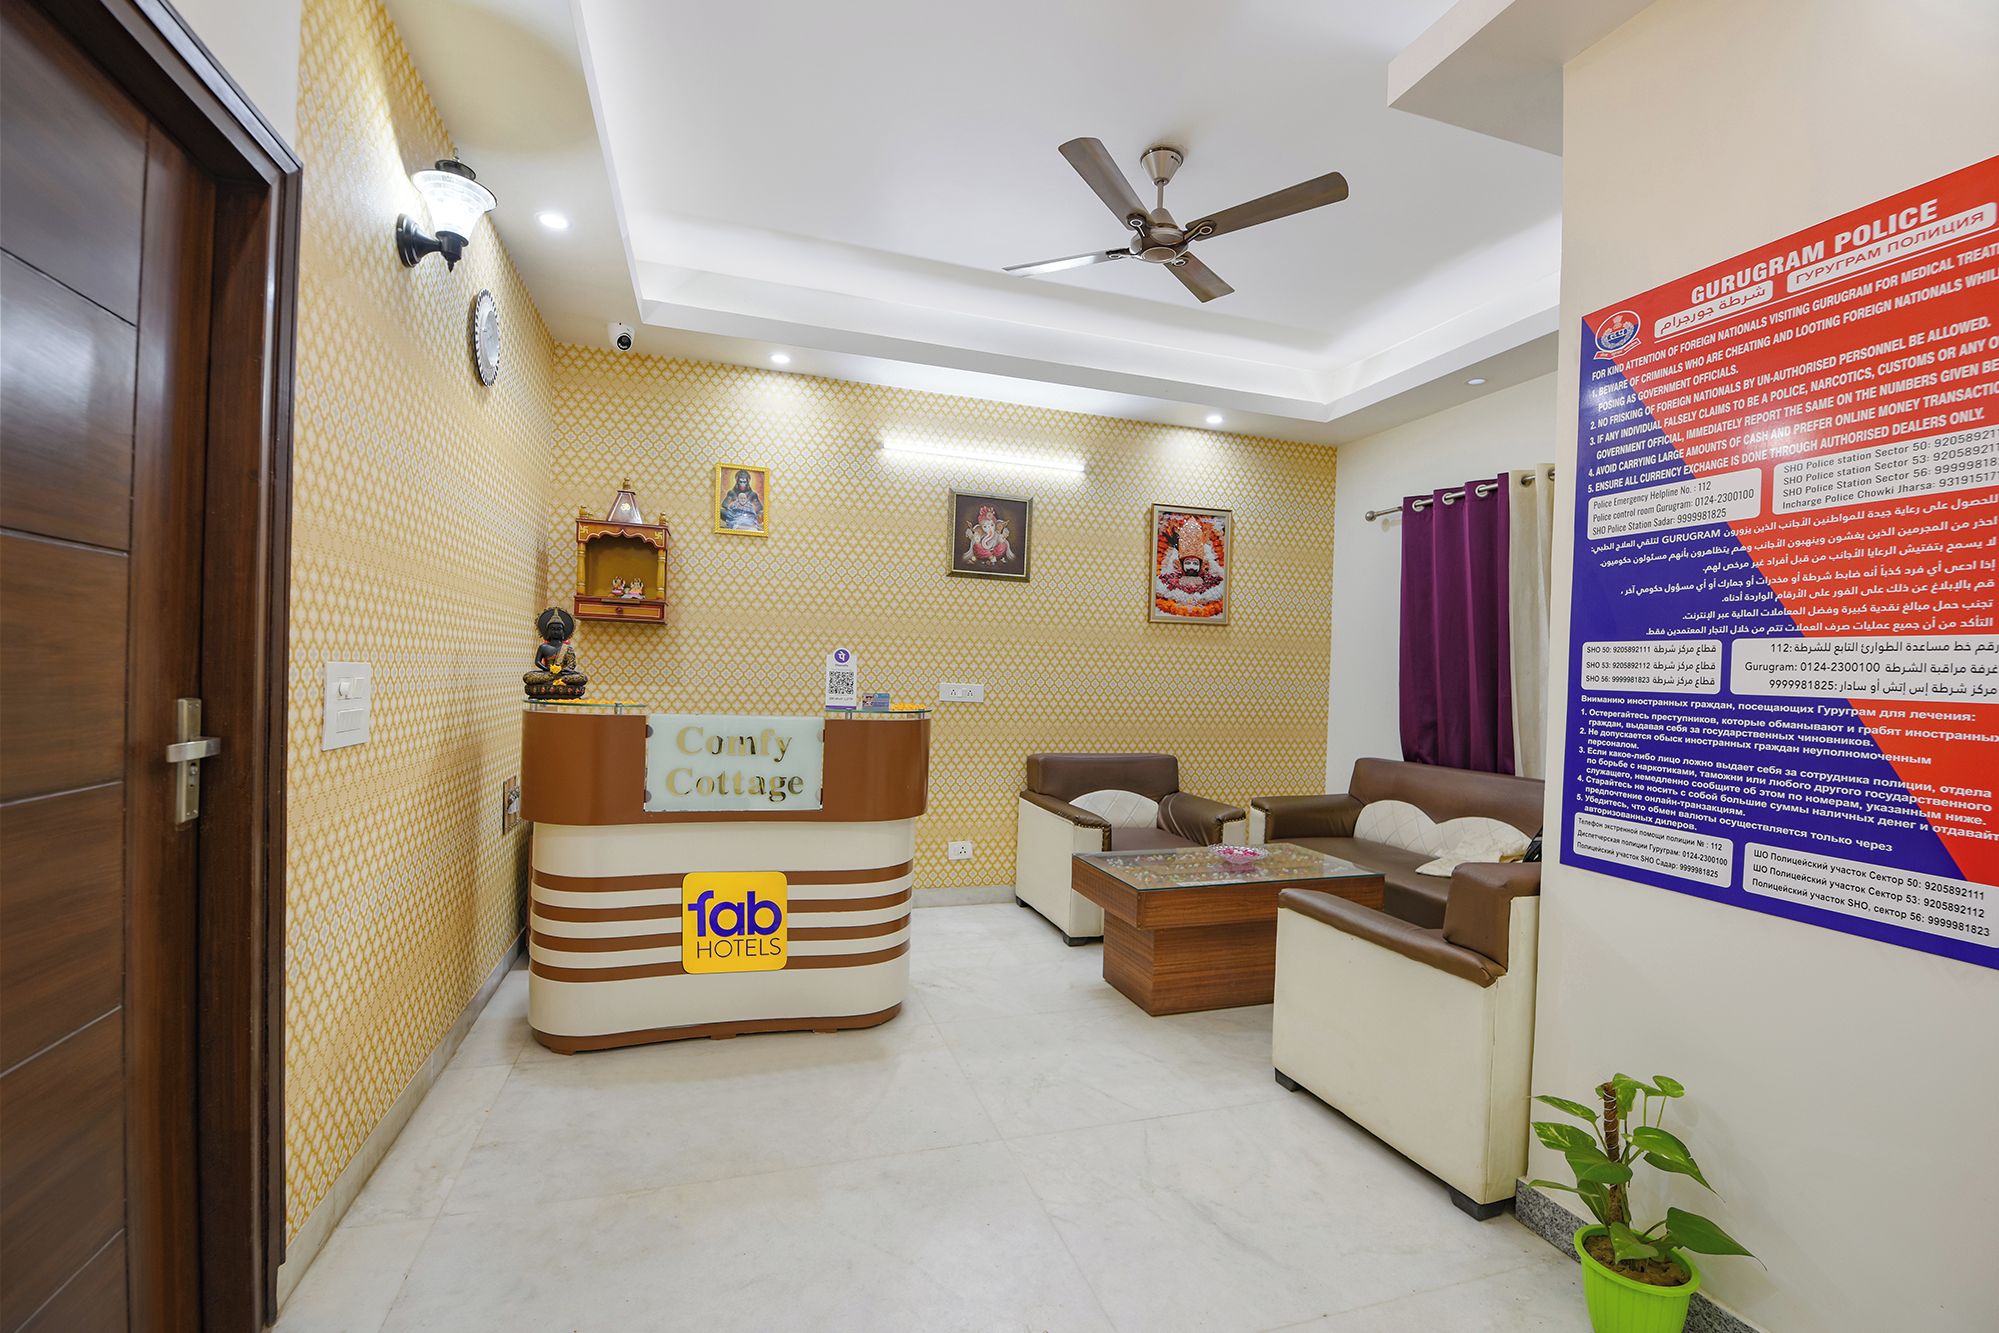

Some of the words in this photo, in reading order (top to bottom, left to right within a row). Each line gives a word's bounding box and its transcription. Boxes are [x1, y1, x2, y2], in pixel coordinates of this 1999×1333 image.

[1691, 241, 1824, 303] GURUGRAM
[1834, 199, 1937, 252] POLICE
[1796, 245, 1881, 284] ГУРУГРАМ
[1887, 209, 1984, 255] ПОЛИЦИЯ
[1591, 368, 1606, 380] FOR
[1606, 363, 1624, 376] KIND
[1625, 349, 1666, 370] ATTENTION
[1667, 344, 1678, 356] OF
[1679, 333, 1716, 352] FOREIGN
[1717, 316, 1767, 340] NATIONALS
[1769, 303, 1810, 324] VISITING
[1812, 283, 1873, 310] GURUGRAM
[1875, 274, 1898, 291] FOR
[1900, 258, 1955, 283] MEDICAL
[1598, 378, 1628, 396] BEWARE
[1629, 375, 1640, 387] OF
[1640, 362, 1683, 383] CRIMINALS
[1684, 356, 1704, 369] WHO
[1705, 350, 1723, 363] ARE
[1725, 336, 1770, 357] CHEATING
[1772, 329, 1793, 344] AND
[1795, 315, 1840, 337] LOOTING
[1842, 299, 1892, 323] FOREIGN
[1894, 278, 1962, 308] NATIONALS
[1965, 268, 1999, 287] WHIL
[1589, 436, 1595, 445] 3.
[1596, 433, 1604, 443] IF
[1604, 430, 1619, 441] ANY
[1620, 420, 1662, 437] INDIVIDUAL
[1663, 410, 1697, 427] FALSELY
[1698, 402, 1730, 418] CLAIMS
[1732, 398, 1745, 410] TO
[1746, 394, 1759, 407] BE
[1760, 393, 1768, 404] A
[1770, 383, 1808, 401] POLICE,
[1810, 367, 1875, 391] NARCOTICS,
[1877, 351, 1935, 375] CUSTOMS
[1937, 346, 1956, 361] OR
[1958, 339, 1986, 356] ANY
[1590, 420, 1596, 430] 2.
[1597, 417, 1608, 427] NO
[1609, 407, 1643, 424] FRISKING
[1644, 404, 1655, 415] OF
[1656, 395, 1691, 412] FOREIGN
[1693, 381, 1741, 402] NATIONALS
[1743, 377, 1755, 389] BY
[1756, 356, 1836, 385] UN-AUTHORISED
[1839, 338, 1906, 364] PERSONNEL
[1908, 332, 1925, 347] BE
[1926, 316, 1991, 341] ALLOWED.
[1598, 395, 1625, 412] POSING
[1626, 393, 1636, 404] AS
[1637, 377, 1691, 400] GOVERNMENT
[1692, 364, 1738, 385] OFFICIALS.
[1596, 440, 1646, 459] GOVERNMENT
[1647, 432, 1684, 448] OFFICIAL,
[1686, 418, 1742, 439] IMMEDIATELY
[1744, 407, 1782, 427] REPORT
[1783, 403, 1803, 417] THE
[1805, 396, 1834, 412] SAME
[1836, 392, 1852, 405] ON
[1854, 386, 1877, 401] THE
[1879, 373, 1937, 395] NUMBERS
[1940, 363, 1979, 382] GIVEN
[1587, 484, 1594, 493] 5.
[1595, 477, 1623, 491] ENSURE
[1624, 475, 1638, 486] ALL
[1639, 466, 1682, 482] CURRENCY
[1683, 457, 1728, 474] EXCHANGE
[1730, 454, 1739, 466] IS
[1741, 448, 1767, 464] DONE
[1769, 438, 1817, 459] THROUGH
[1819, 426, 1889, 448] AUTHORISED
[1891, 414, 1946, 435] DEALERS
[1949, 407, 1984, 424] ONLY.
[1588, 468, 1594, 477] 4.
[1595, 463, 1617, 475] AVOID
[1618, 454, 1656, 470] CARRYING
[1658, 448, 1684, 462] LARGE
[1685, 439, 1727, 456] AMOUNTS
[1728, 436, 1741, 448] OF
[1742, 429, 1768, 446] CASH
[1770, 424, 1791, 440] AND
[1792, 417, 1832, 434] PREFER
[1835, 407, 1876, 425] ONLINE
[1878, 398, 1920, 416] MONEY
[1783, 462, 1803, 473] SHO
[1805, 459, 1834, 469] Police
[1837, 452, 1871, 464] station
[1874, 446, 1909, 457] Sector
[1912, 440, 1931, 451] 50:
[1592, 513, 1611, 522] Police
[1612, 508, 1635, 519] control
[1636, 506, 1654, 515] room
[1655, 501, 1693, 512] Gurugram:
[1694, 488, 1754, 506] 0124-2300100
[1593, 500, 1612, 509] Police
[1613, 494, 1648, 506] Emergency
[1649, 488, 1678, 499] Helpline
[1679, 485, 1692, 494] No.
[1697, 480, 1711, 491] 112
[1782, 498, 1822, 509] Incharge
[1824, 493, 1854, 503] Police
[1857, 486, 1894, 498] Chowki
[1897, 482, 1935, 493] Jharsa:
[1592, 525, 1606, 535] SHO
[1607, 524, 1626, 533] Police
[1627, 520, 1651, 530] Station
[1653, 516, 1675, 527] Sadar:
[1676, 507, 1726, 523] 9999981825
[1581, 694, 1625, 703] Вниманию
[1626, 698, 1688, 706] иностранных
[1690, 701, 1735, 710] граждан,
[1738, 703, 1814, 713] посещающих
[1817, 705, 1876, 716] Гуруграм
[1878, 710, 1905, 718] для
[1909, 711, 1975, 721] лечения:
[676, 725, 793, 763] Comfy
[665, 767, 804, 802] Cottage
[687, 890, 782, 937] fab
[1752, 878, 1807, 896] Полицейский
[1809, 892, 1845, 905] участок
[1847, 898, 1870, 911] SHO,
[1873, 906, 1907, 919] сектор
[1909, 911, 1924, 922] 56:
[1927, 916, 1990, 936] 9999981823
[697, 938, 781, 959] HOTELS
